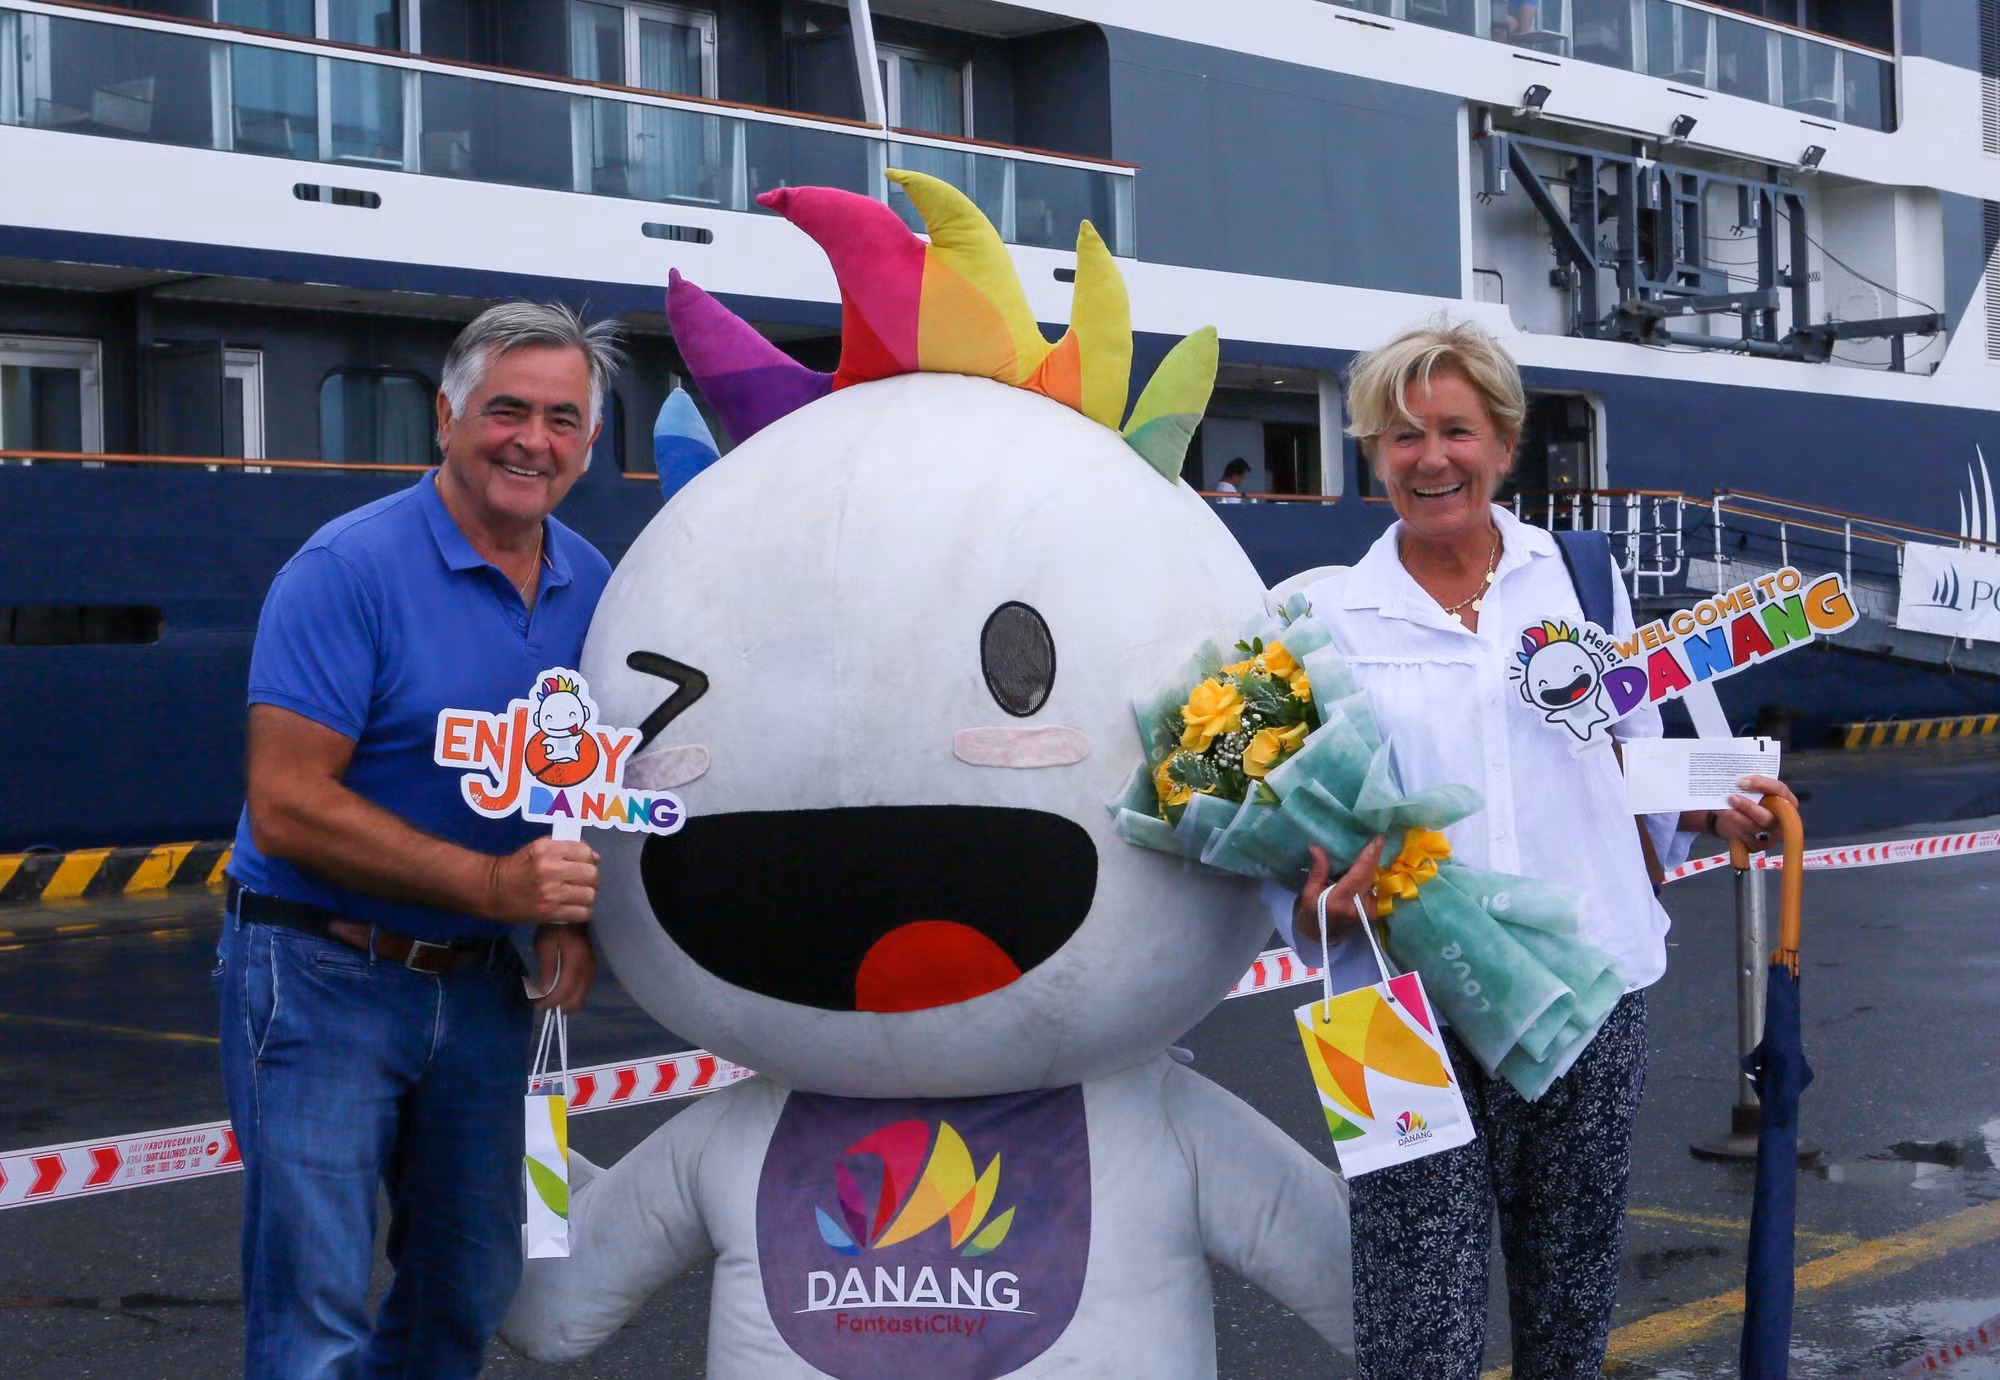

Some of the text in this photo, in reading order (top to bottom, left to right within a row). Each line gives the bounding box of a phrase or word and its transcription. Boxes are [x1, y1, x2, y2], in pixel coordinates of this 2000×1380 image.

[1612, 569, 1800, 660] WELCOME TO
[1583, 629, 1623, 668] Hello!
[442, 706, 634, 812] ENJOY
[1397, 1130, 1433, 1147] DANANG
[808, 1266, 1020, 1311] DANANG
